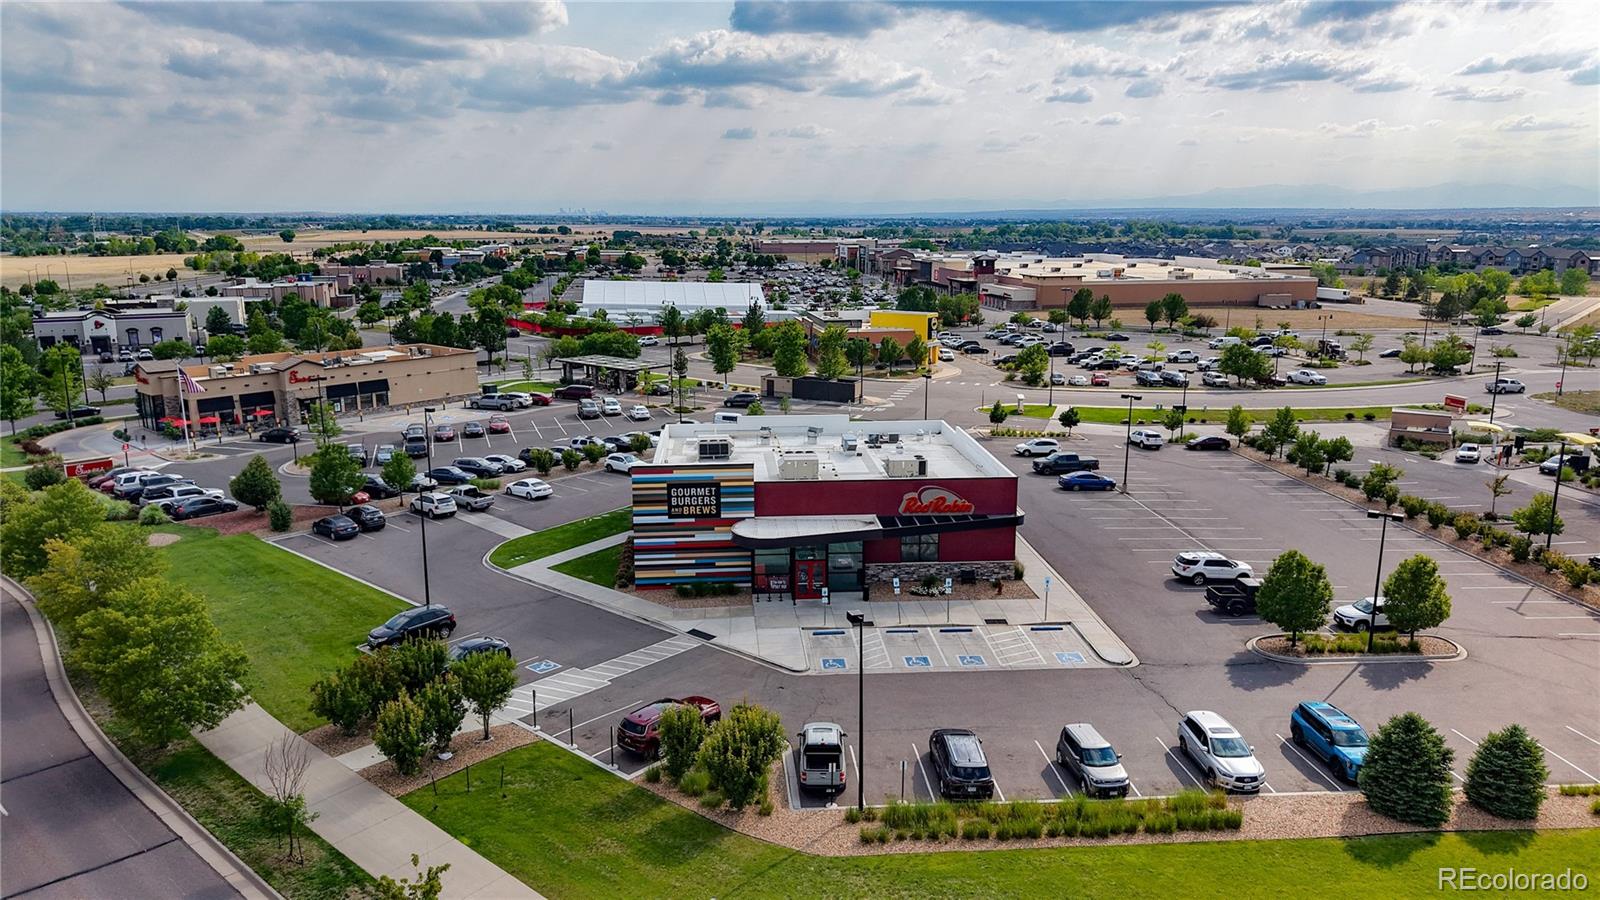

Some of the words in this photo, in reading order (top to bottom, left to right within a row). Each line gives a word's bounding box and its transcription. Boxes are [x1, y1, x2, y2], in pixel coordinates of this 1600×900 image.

[671, 487, 716, 496] GOURMET
[671, 496, 716, 505] BURGERS
[902, 496, 930, 512] Red
[927, 495, 973, 512] Robin
[683, 505, 716, 514] BREWS
